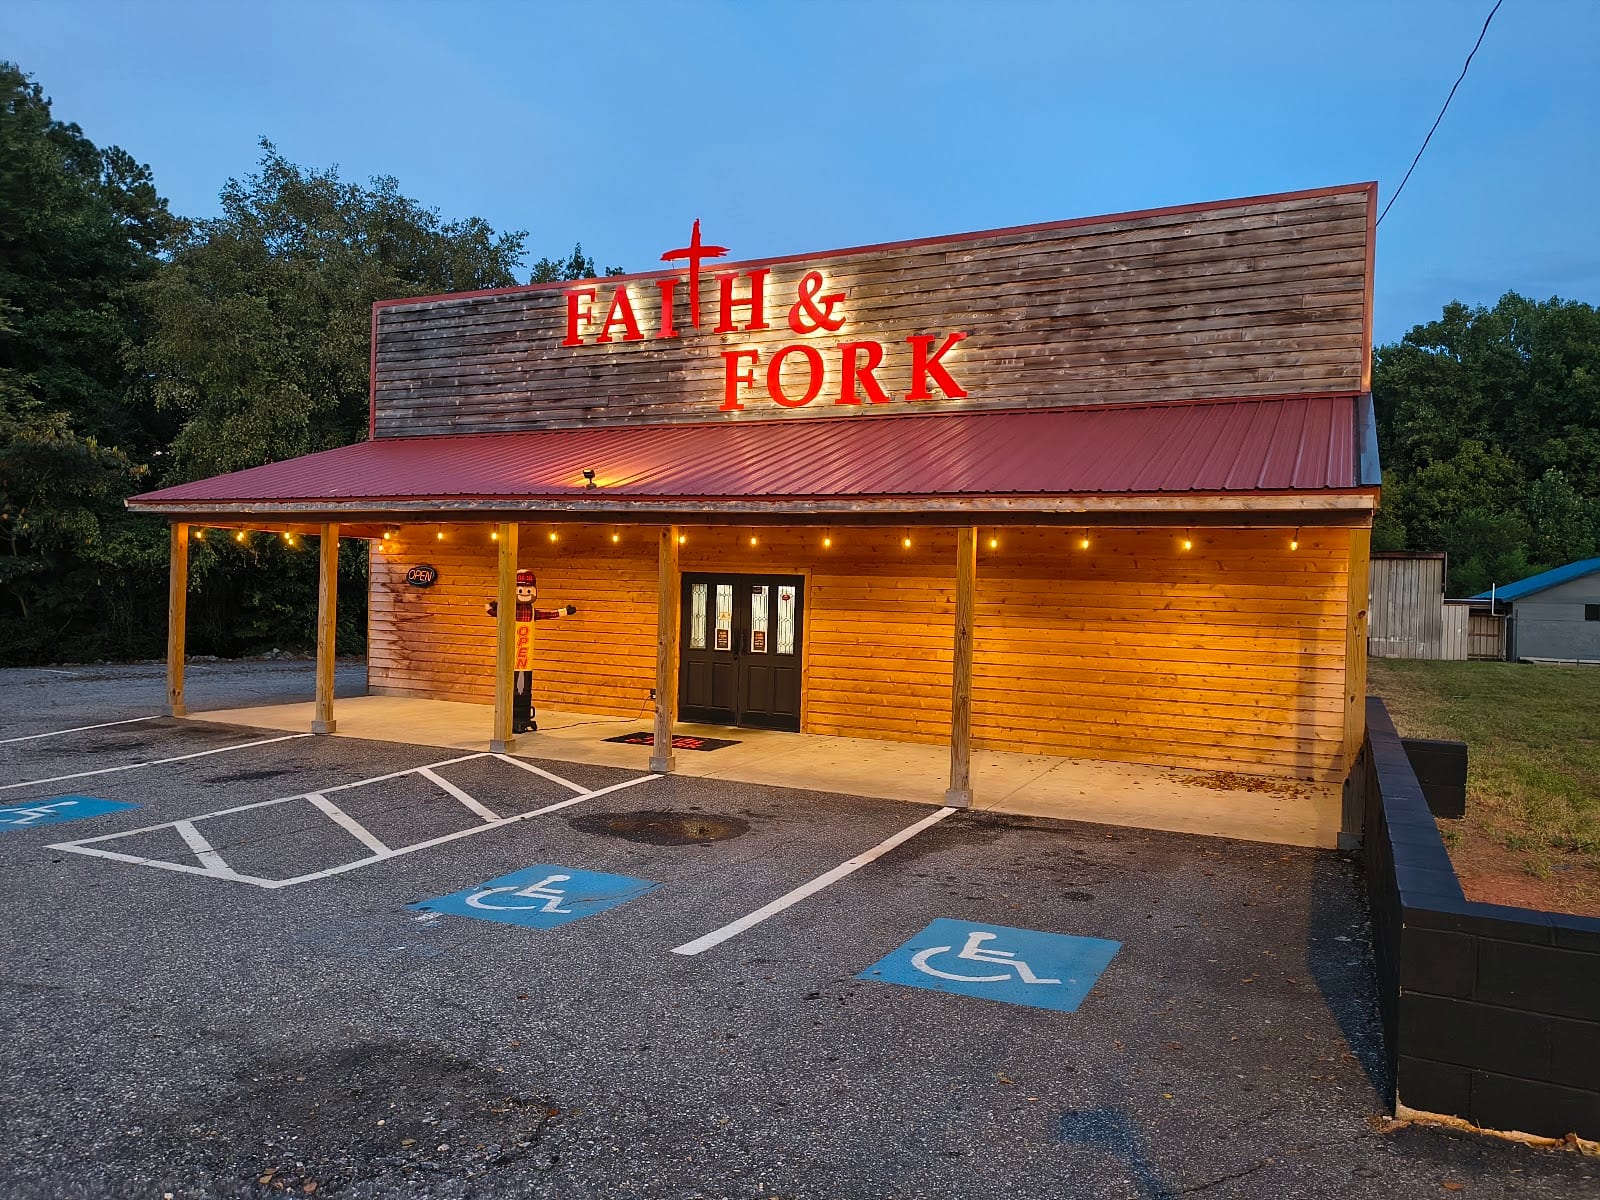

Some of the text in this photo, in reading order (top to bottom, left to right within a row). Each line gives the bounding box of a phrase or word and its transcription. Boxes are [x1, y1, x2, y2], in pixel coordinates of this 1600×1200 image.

[562, 218, 847, 346] FAITH &
[719, 332, 968, 411] FORK
[408, 569, 433, 582] OPEN
[516, 626, 530, 670] OPEN
